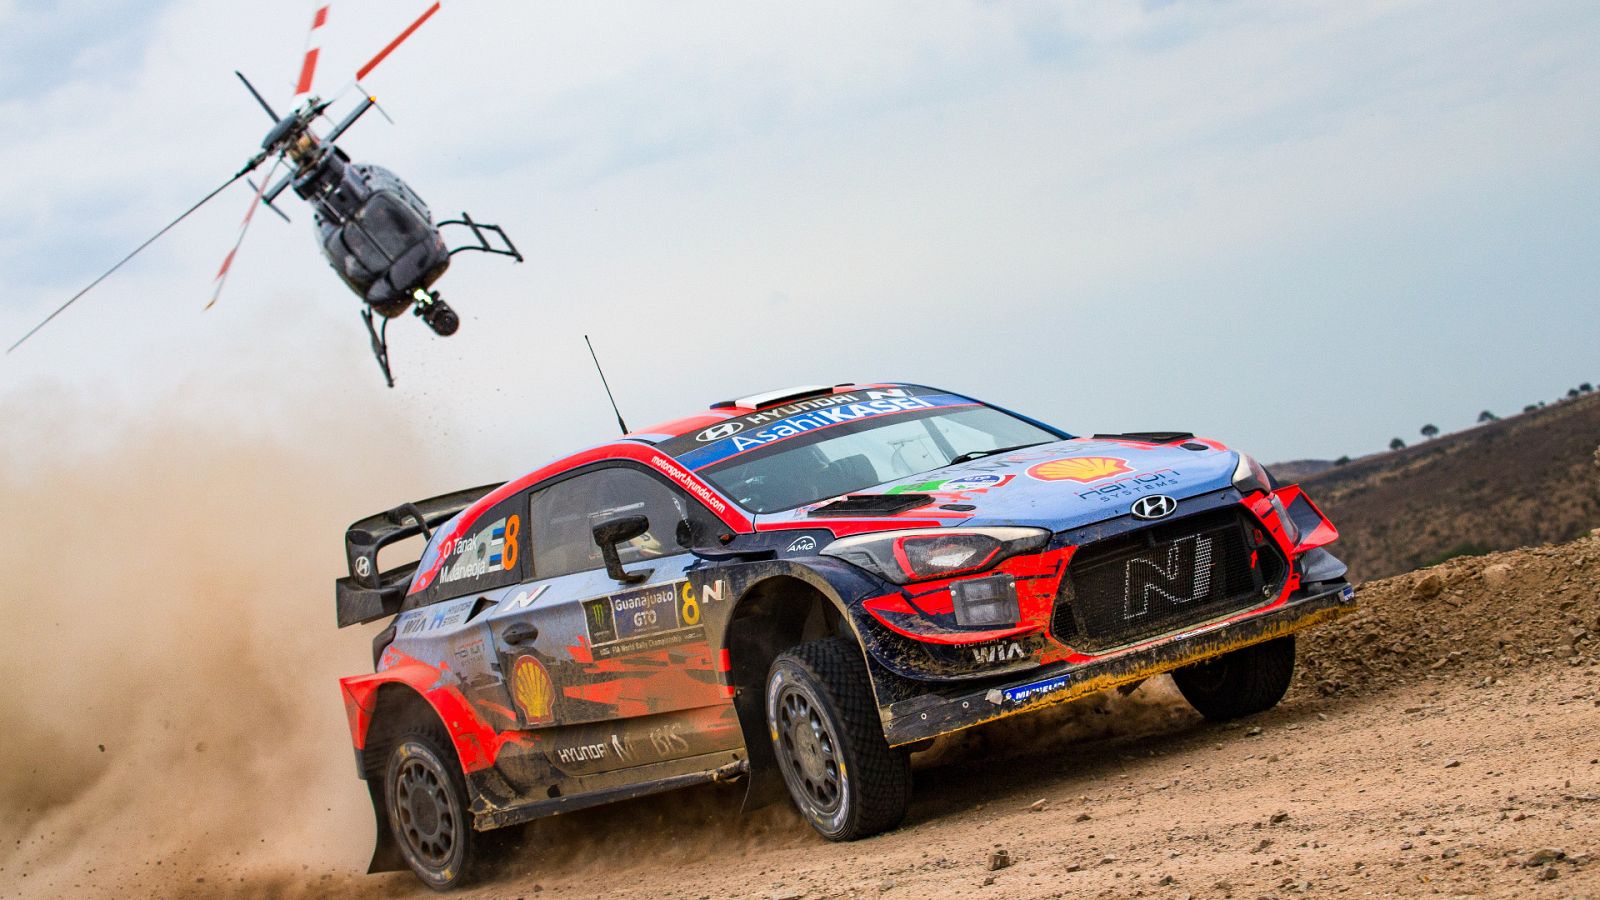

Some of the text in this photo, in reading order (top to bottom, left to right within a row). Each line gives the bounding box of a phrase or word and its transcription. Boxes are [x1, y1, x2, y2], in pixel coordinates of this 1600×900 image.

[746, 394, 859, 425] HYUNDAI
[651, 455, 726, 513] motorsport.hyundai.com
[1100, 479, 1178, 502] SYSTEMS
[443, 541, 452, 558] O
[503, 514, 520, 571] 8
[786, 543, 814, 552] AMG
[614, 590, 674, 612] Guanajuato
[702, 579, 725, 603] N
[633, 609, 657, 627] GTO
[972, 642, 1025, 664] WIA
